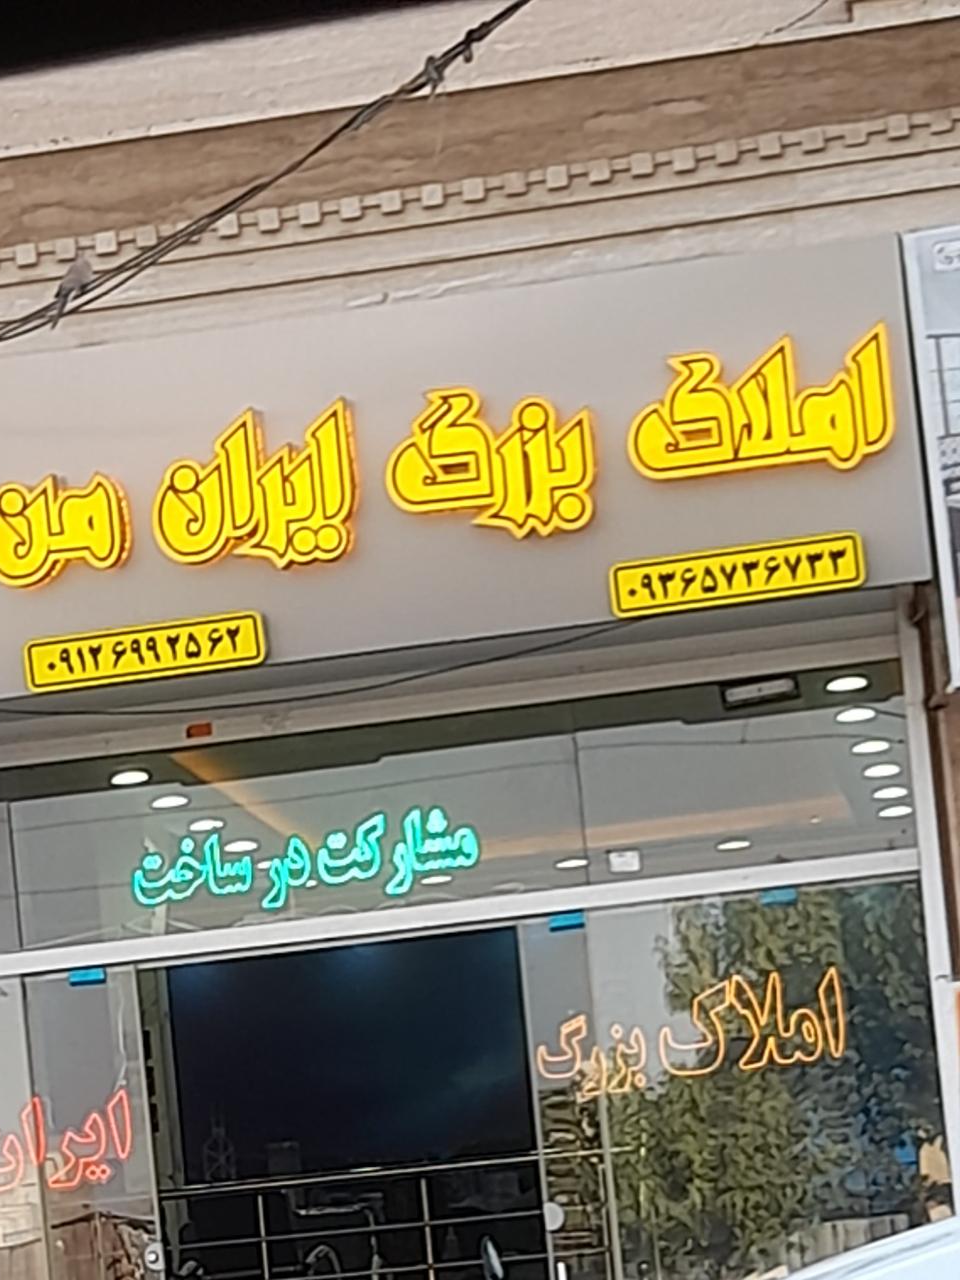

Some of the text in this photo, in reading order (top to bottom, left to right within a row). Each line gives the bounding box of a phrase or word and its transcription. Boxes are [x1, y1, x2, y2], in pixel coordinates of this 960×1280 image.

[386, 387, 595, 538] بزرگ
[628, 322, 894, 478] املاک
[152, 397, 355, 568] ایران
[627, 546, 847, 600] ۰۹۳۶۵۷۳۶۷۳۳
[46, 624, 241, 674] ۰۹۱۲۶۹۹۲۵۶۲
[132, 807, 479, 911] مشارکت در ساخت
[535, 966, 846, 1101] املاک بزرگ
